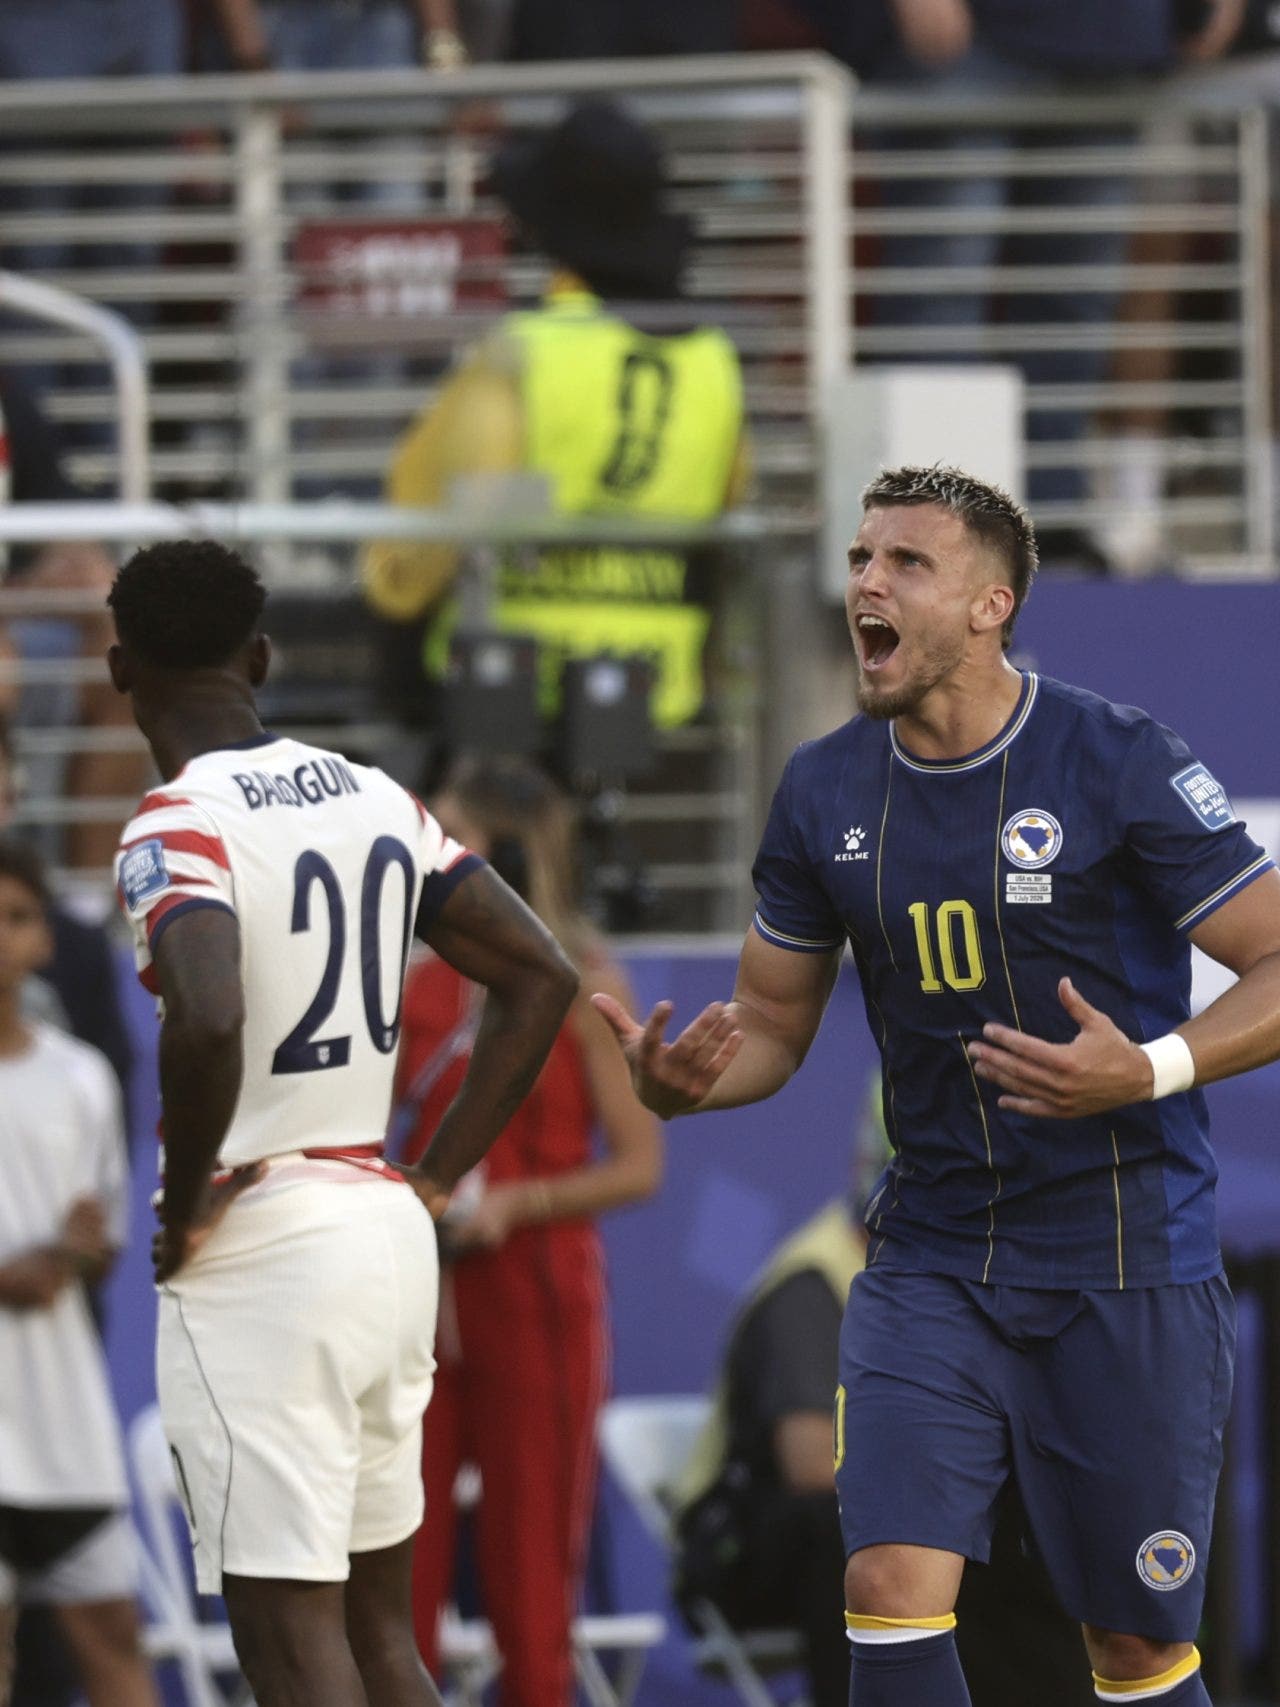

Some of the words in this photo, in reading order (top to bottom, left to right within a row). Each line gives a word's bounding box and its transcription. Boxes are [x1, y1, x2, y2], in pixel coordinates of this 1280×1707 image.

[834, 851, 870, 862] KELME
[271, 834, 416, 1076] 20
[907, 899, 987, 993] 10
